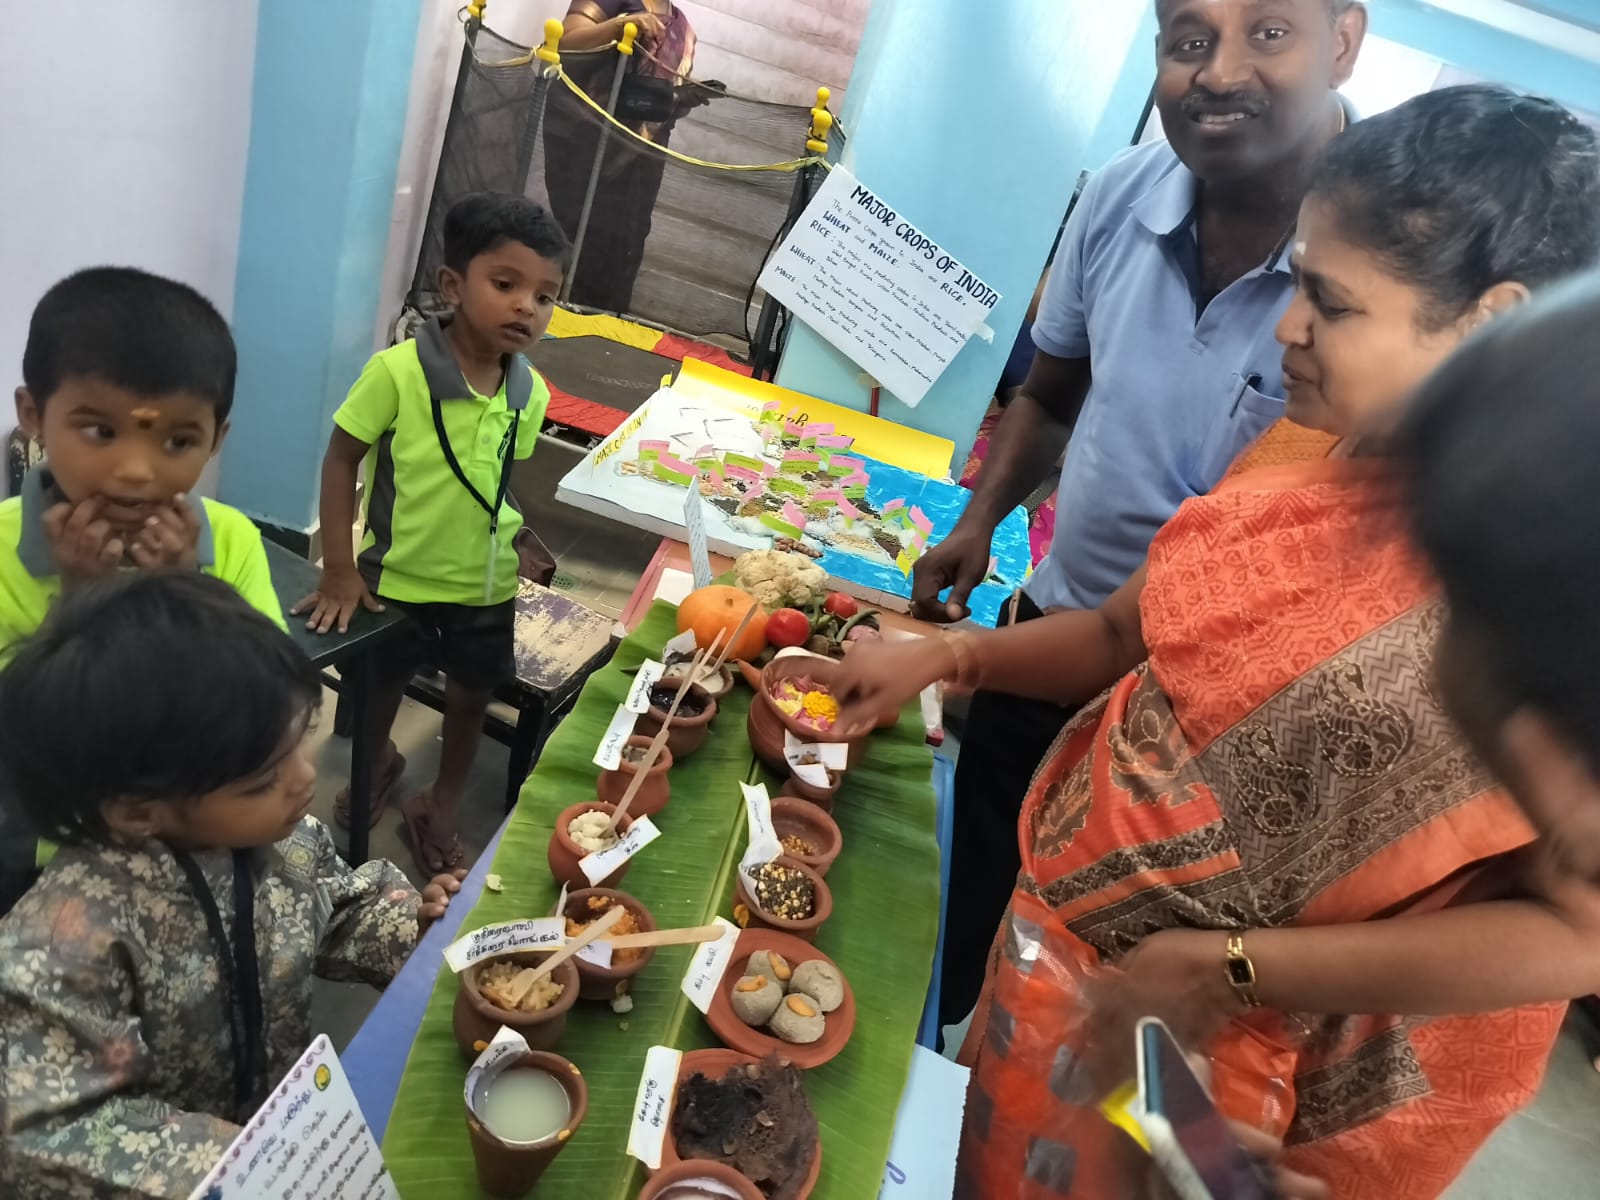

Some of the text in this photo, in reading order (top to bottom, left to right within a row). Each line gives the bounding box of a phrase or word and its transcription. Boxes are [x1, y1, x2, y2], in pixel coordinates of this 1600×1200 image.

[810, 219, 832, 238] RICE
[822, 210, 851, 234] WHEAT
[790, 245, 816, 265] WHEAT
[850, 185, 998, 309] MAJOR CROPS OF INDIA
